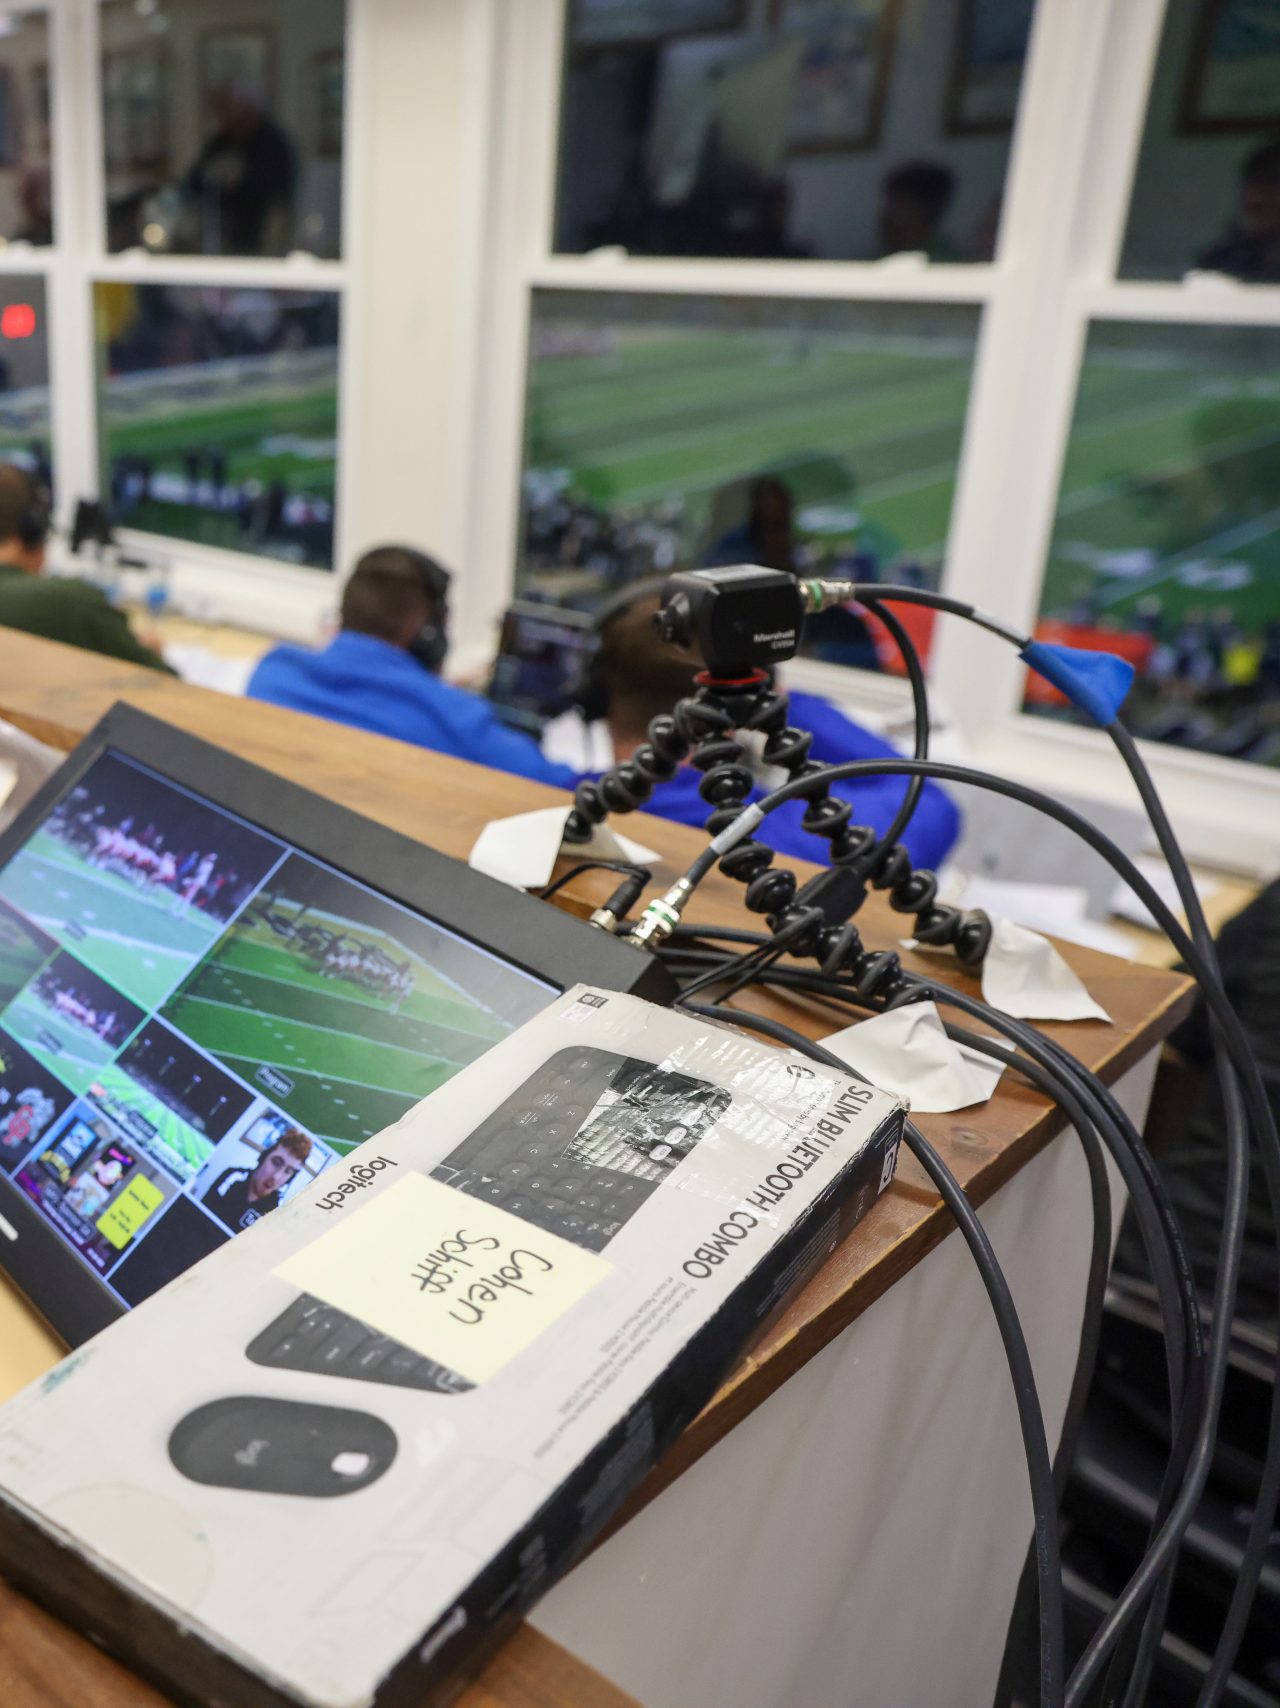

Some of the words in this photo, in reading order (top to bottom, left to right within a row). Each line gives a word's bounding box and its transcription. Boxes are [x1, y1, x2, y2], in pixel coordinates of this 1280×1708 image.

[825, 1085, 872, 1123] SLIM
[314, 1155, 399, 1213] logitech
[744, 1117, 843, 1213] BLUETOOTH
[682, 1211, 759, 1278] COMBO
[447, 1247, 552, 1329] Cohen
